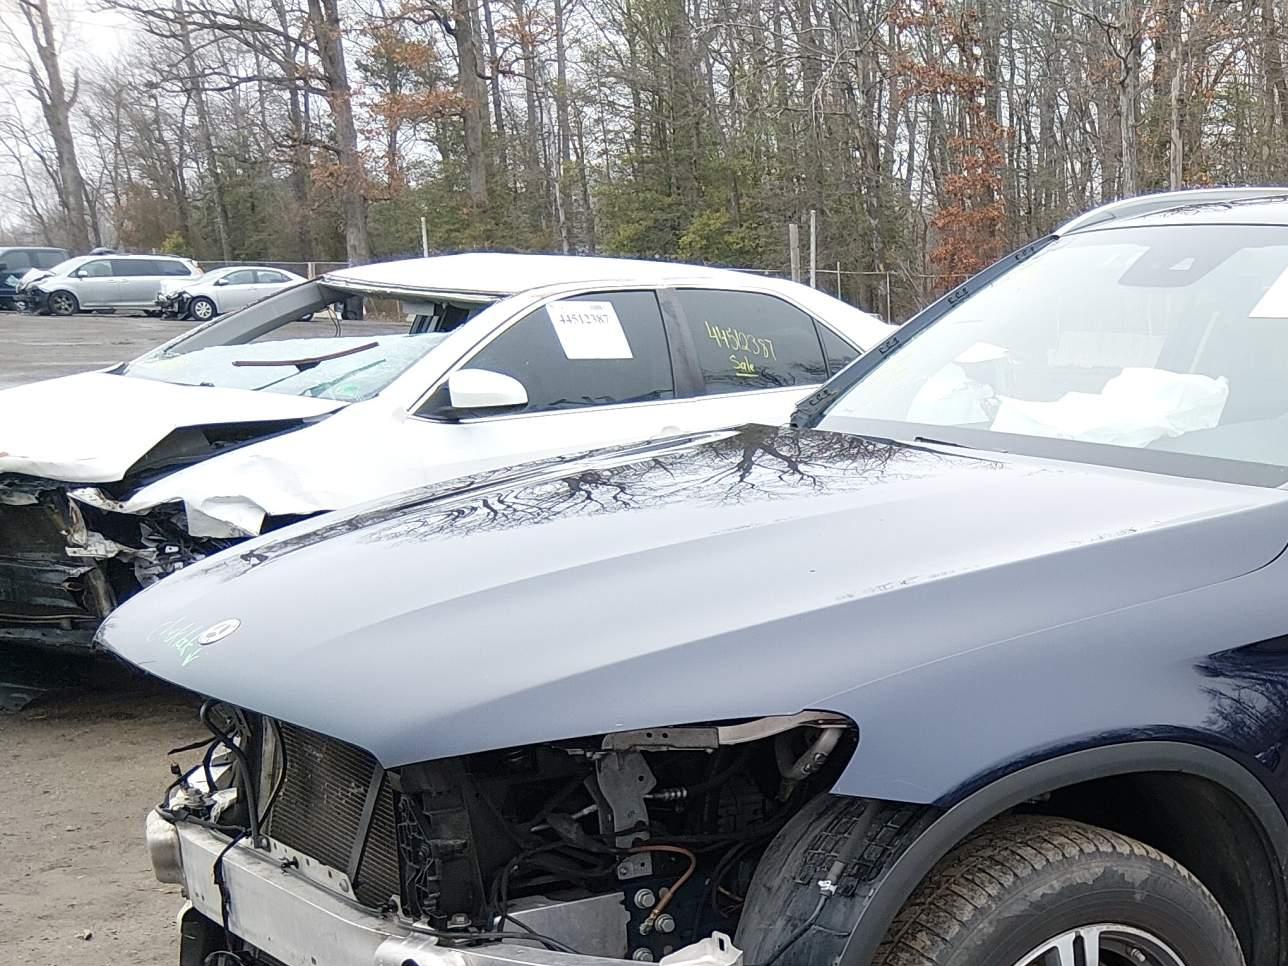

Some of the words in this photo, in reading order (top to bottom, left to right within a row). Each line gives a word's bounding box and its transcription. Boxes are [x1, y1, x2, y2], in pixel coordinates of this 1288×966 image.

[559, 313, 609, 325] 44512387
[704, 320, 777, 361] 44512387
[729, 354, 755, 373] Sale
